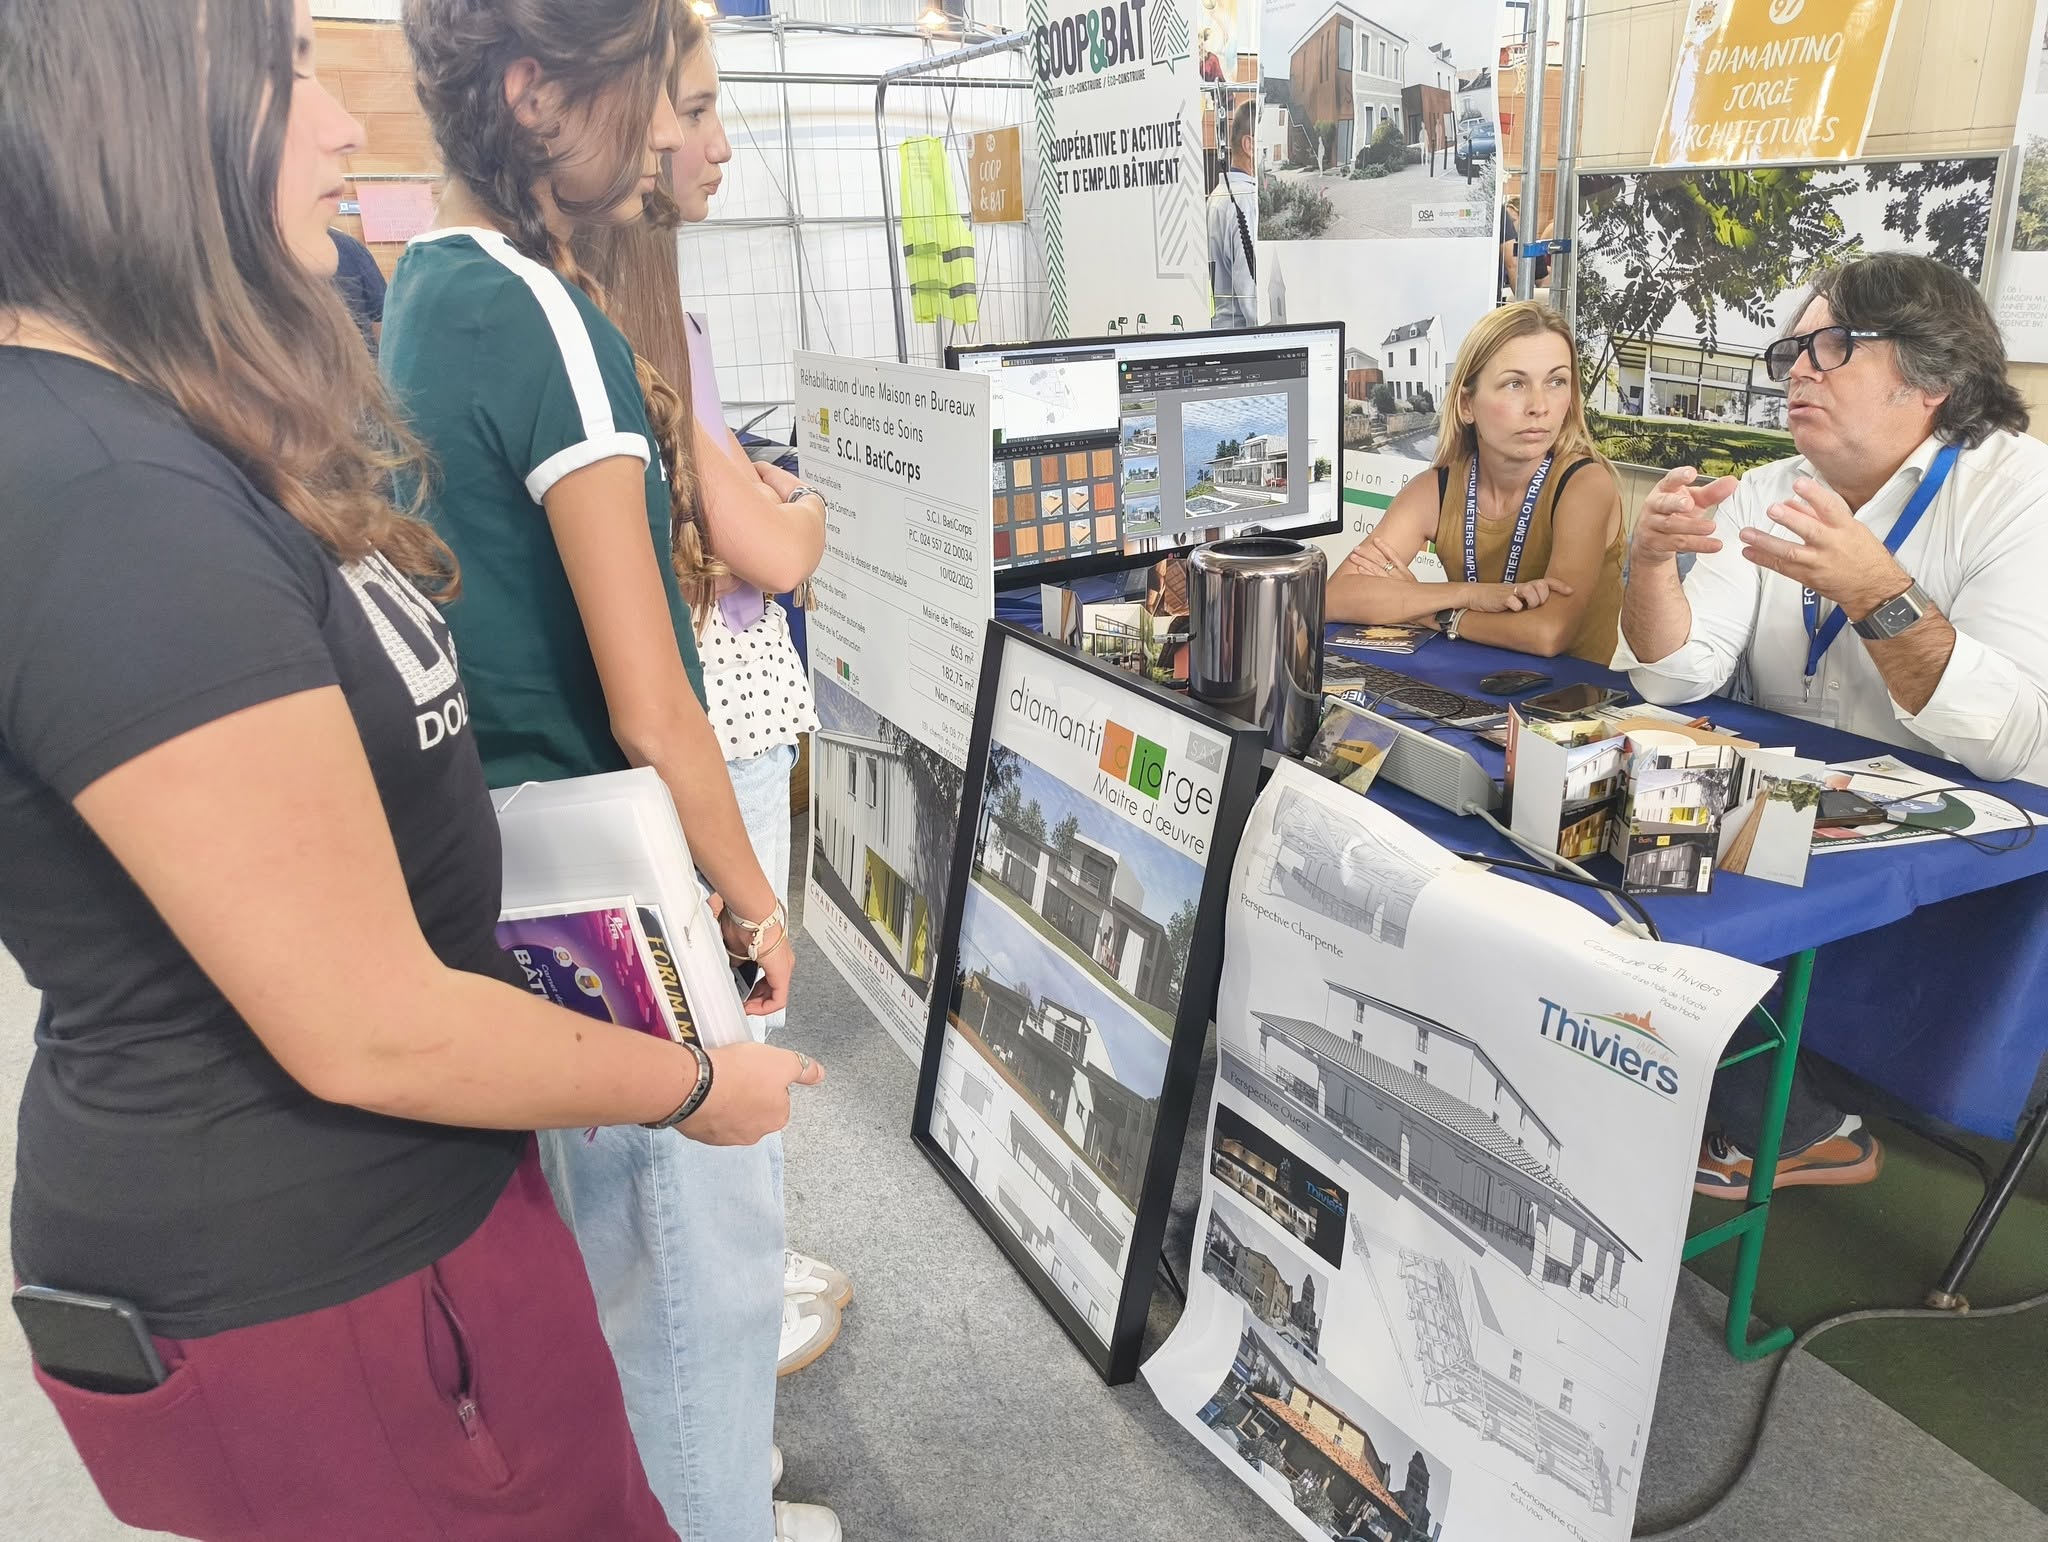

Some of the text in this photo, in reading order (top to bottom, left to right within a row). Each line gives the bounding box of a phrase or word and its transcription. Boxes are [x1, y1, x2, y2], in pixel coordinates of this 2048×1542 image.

[1036, 0, 1146, 82] COOP&BAT
[1704, 31, 1843, 75] DIAMANTINO
[1723, 77, 1799, 112] JORGE
[1050, 113, 1182, 163] COOPÉRATIVE D'ACTIVITÉ
[1671, 116, 1840, 152] ARCHITECTURES
[980, 160, 1002, 182] COOP
[1057, 156, 1179, 195] ET D'EMPLOI BÂTIMENT
[800, 368, 976, 418] Réhabilitation d'une Maison en Bureaux
[833, 407, 924, 443] et Cabinets de Soins
[836, 437, 862, 463] S.C.I.
[865, 445, 921, 484] BatiCorps
[1465, 499, 1476, 546] METIERS
[1514, 502, 1533, 543] EMPLOI
[1526, 457, 1552, 501] TRAVAIL
[908, 528, 973, 563] P.C. 024 557 22 D0034
[926, 509, 973, 538] S.C.I. BatiCorps
[939, 566, 973, 590] 10/02/2023
[922, 604, 975, 639] Mairie de Trelissac
[950, 644, 963, 661] 653
[934, 686, 949, 705] Non
[942, 665, 963, 687] 182,75
[1142, 804, 1205, 855] d'œuvre
[810, 883, 848, 932] CHANTIER
[853, 935, 895, 986] INTERDIT
[901, 988, 914, 1009] AU
[1241, 892, 1344, 958] Perspective Charpente
[646, 936, 687, 1013] FORUM
[1583, 938, 1646, 968] Commune
[1648, 960, 1668, 974] de
[1672, 966, 1723, 998] Thiviers
[1538, 996, 1679, 1096] Thiviers
[1230, 1071, 1311, 1133] Perspective Ouest
